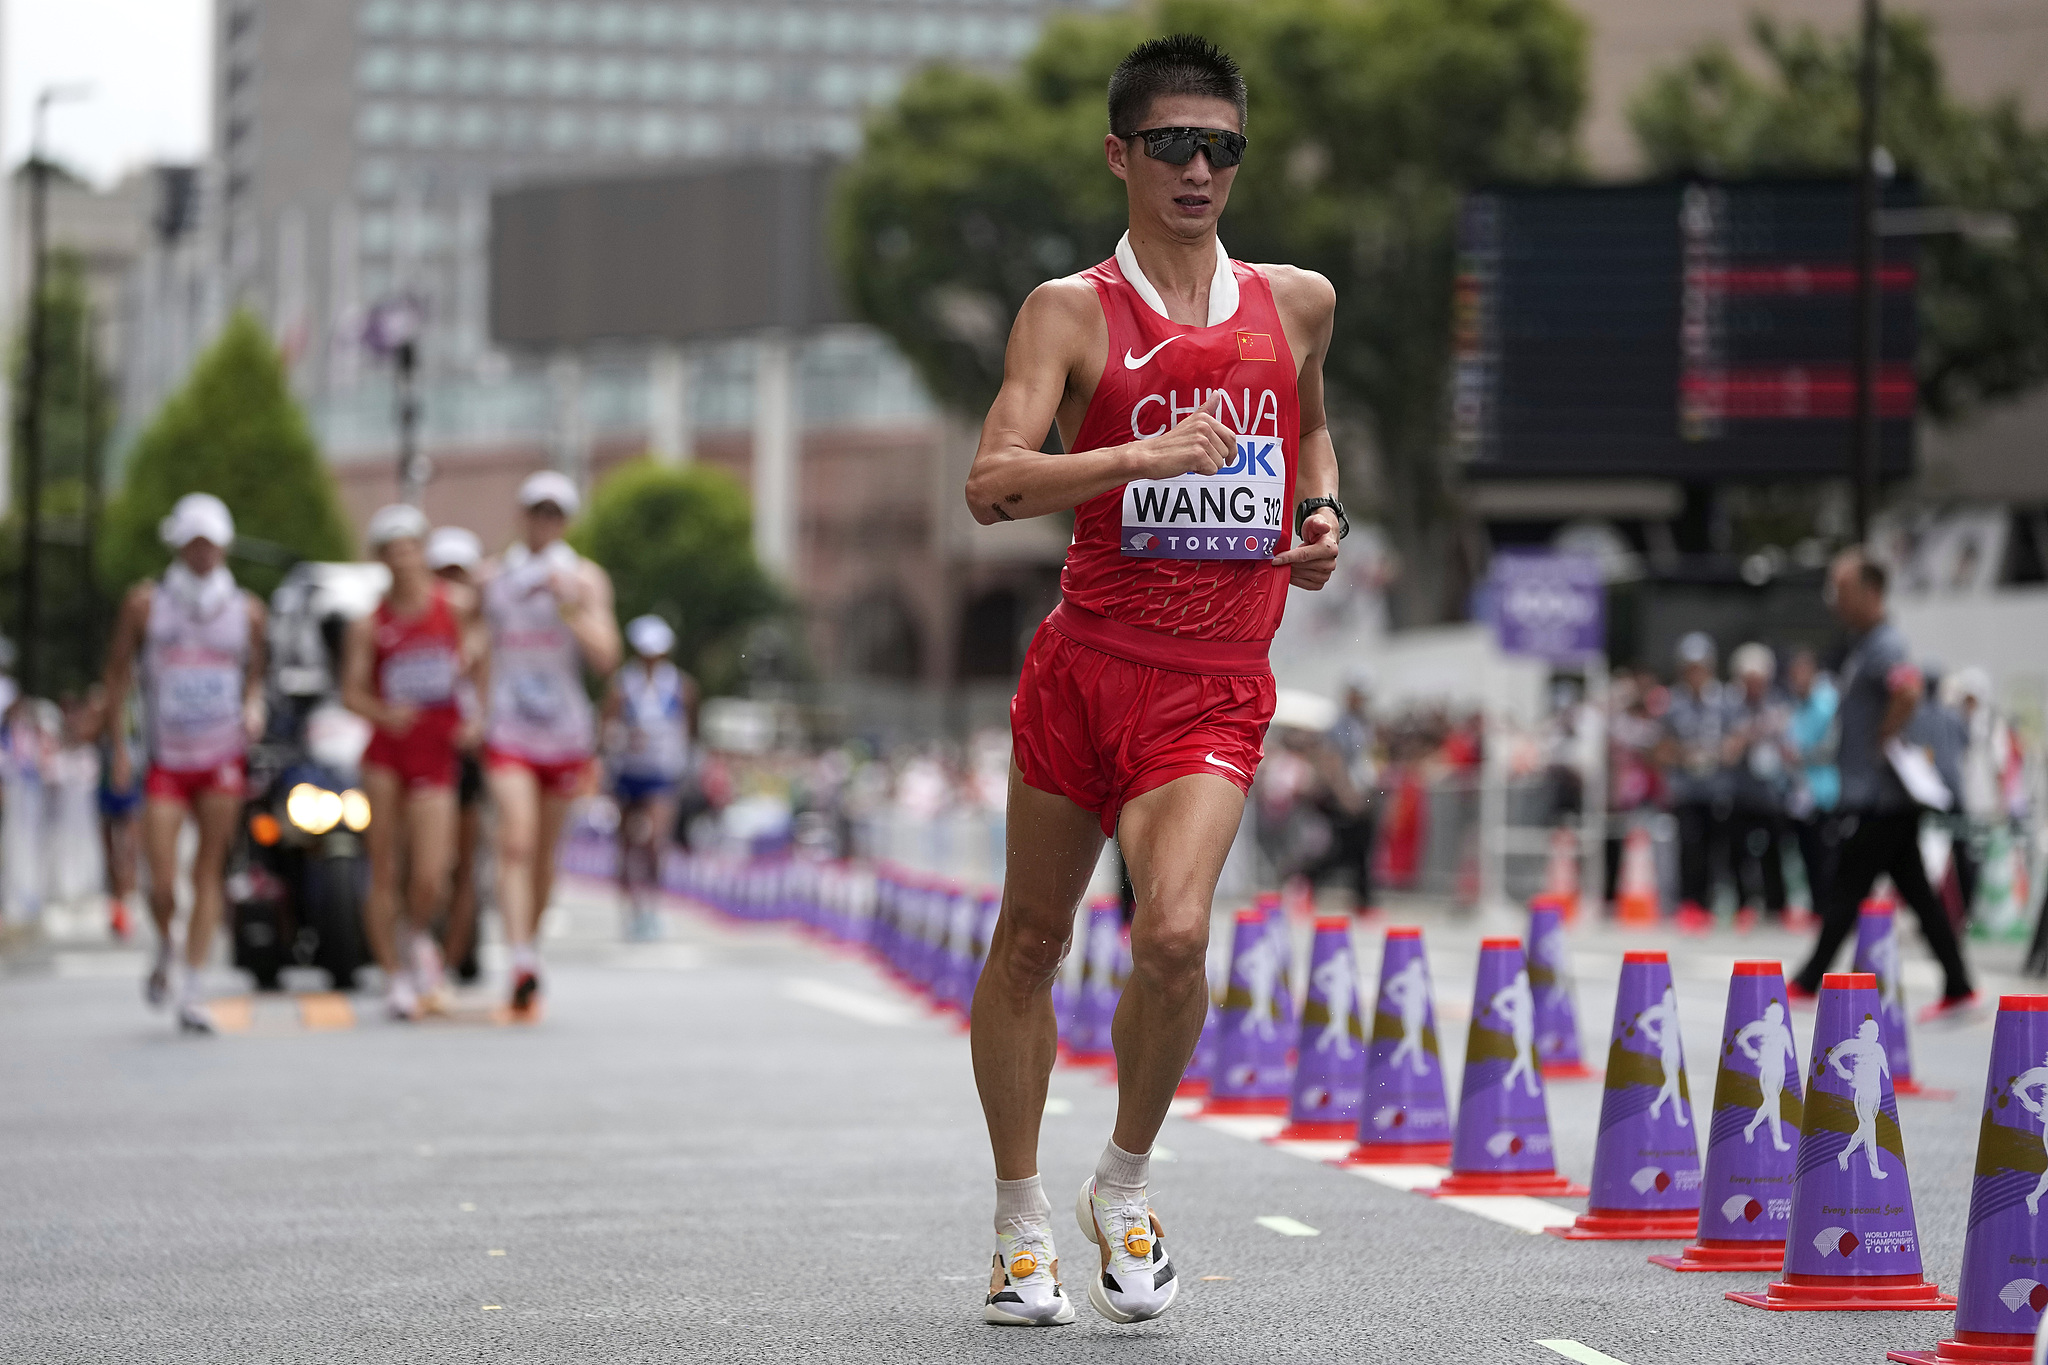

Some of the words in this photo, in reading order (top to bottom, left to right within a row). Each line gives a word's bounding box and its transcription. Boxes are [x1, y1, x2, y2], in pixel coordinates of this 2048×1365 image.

[1186, 441, 1278, 477] DK
[1132, 486, 1256, 523] WANG
[1263, 497, 1281, 526] 312
[1822, 1205, 1847, 1217] Every
[1864, 1231, 1888, 1239] WORLD
[1889, 1229, 1913, 1238] ATHLETICS
[1864, 1236, 1914, 1246] CHAMPIONSHIPS
[2009, 1254, 2038, 1267] Every
